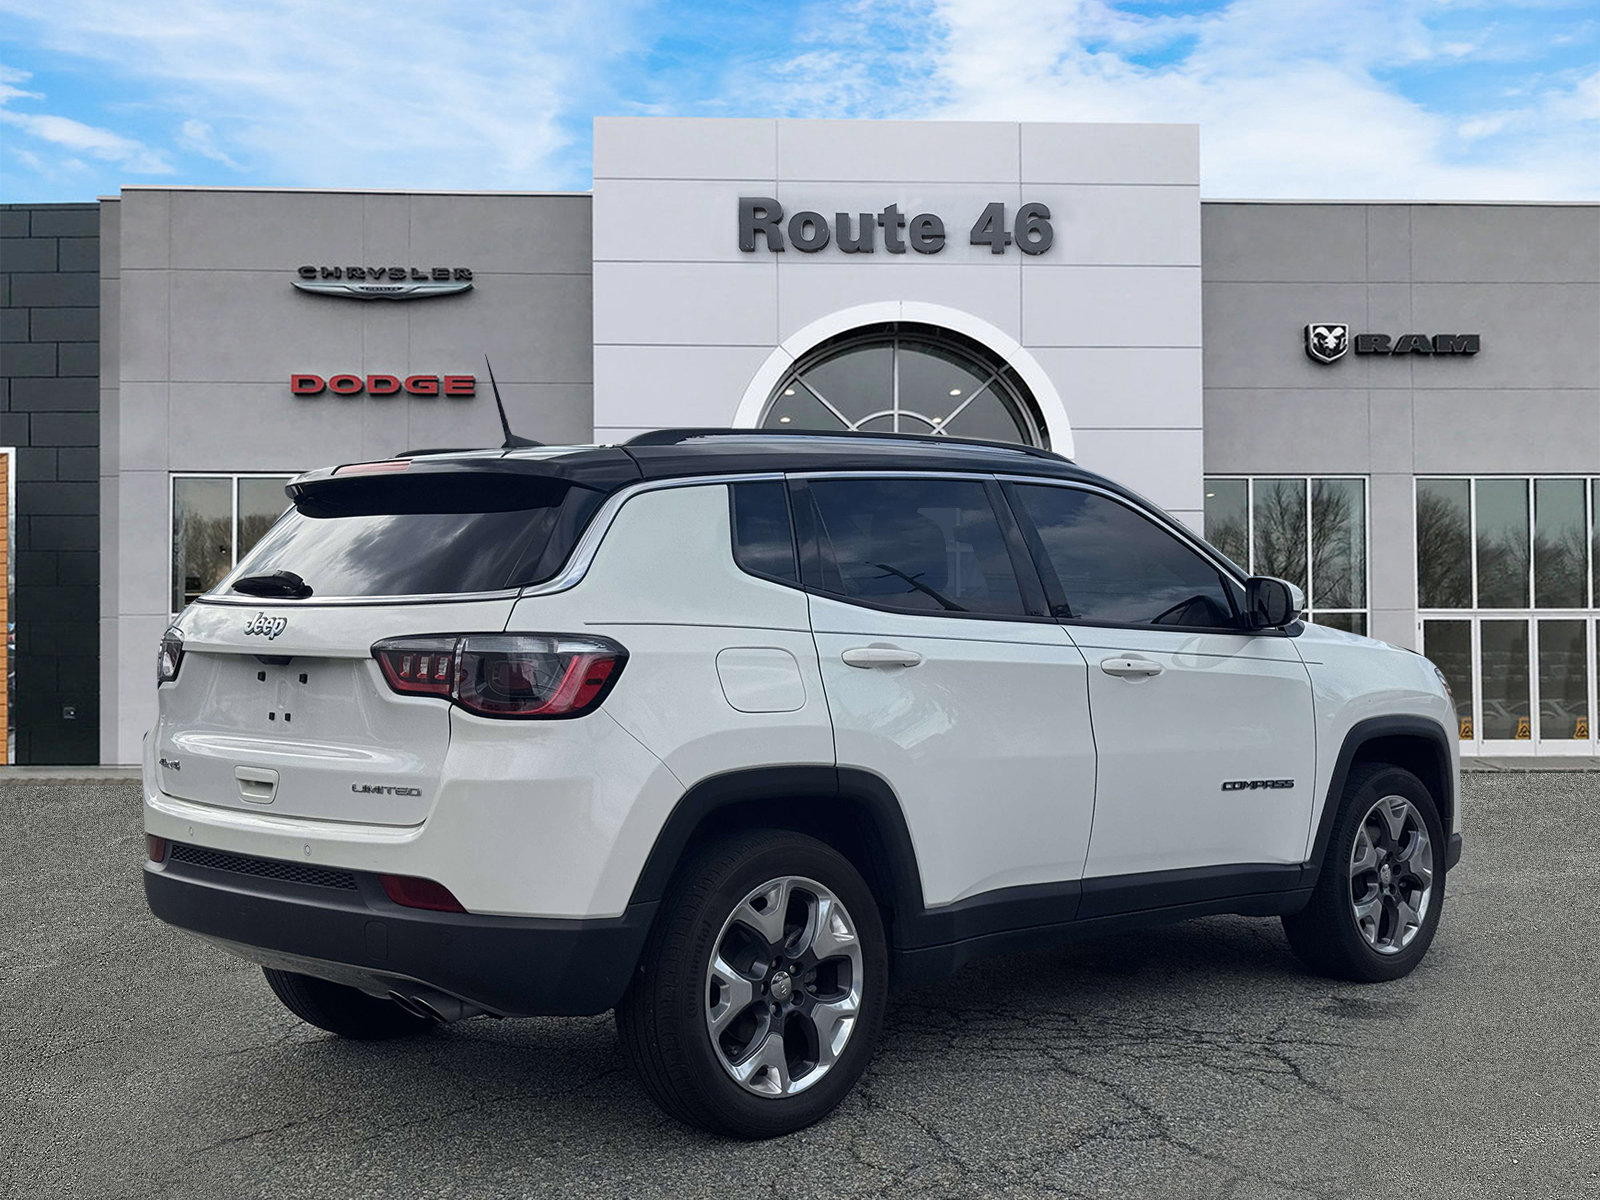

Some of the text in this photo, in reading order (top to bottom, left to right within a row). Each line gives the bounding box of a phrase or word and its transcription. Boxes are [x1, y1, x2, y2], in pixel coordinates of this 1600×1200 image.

[738, 197, 1054, 256] Route 46
[298, 265, 473, 281] CHRYSLER
[1354, 334, 1481, 356] RAM
[291, 374, 476, 397] DODGE
[244, 611, 288, 641] Jeep
[351, 783, 422, 797] LIMITED
[1221, 779, 1295, 791] COMPASS
